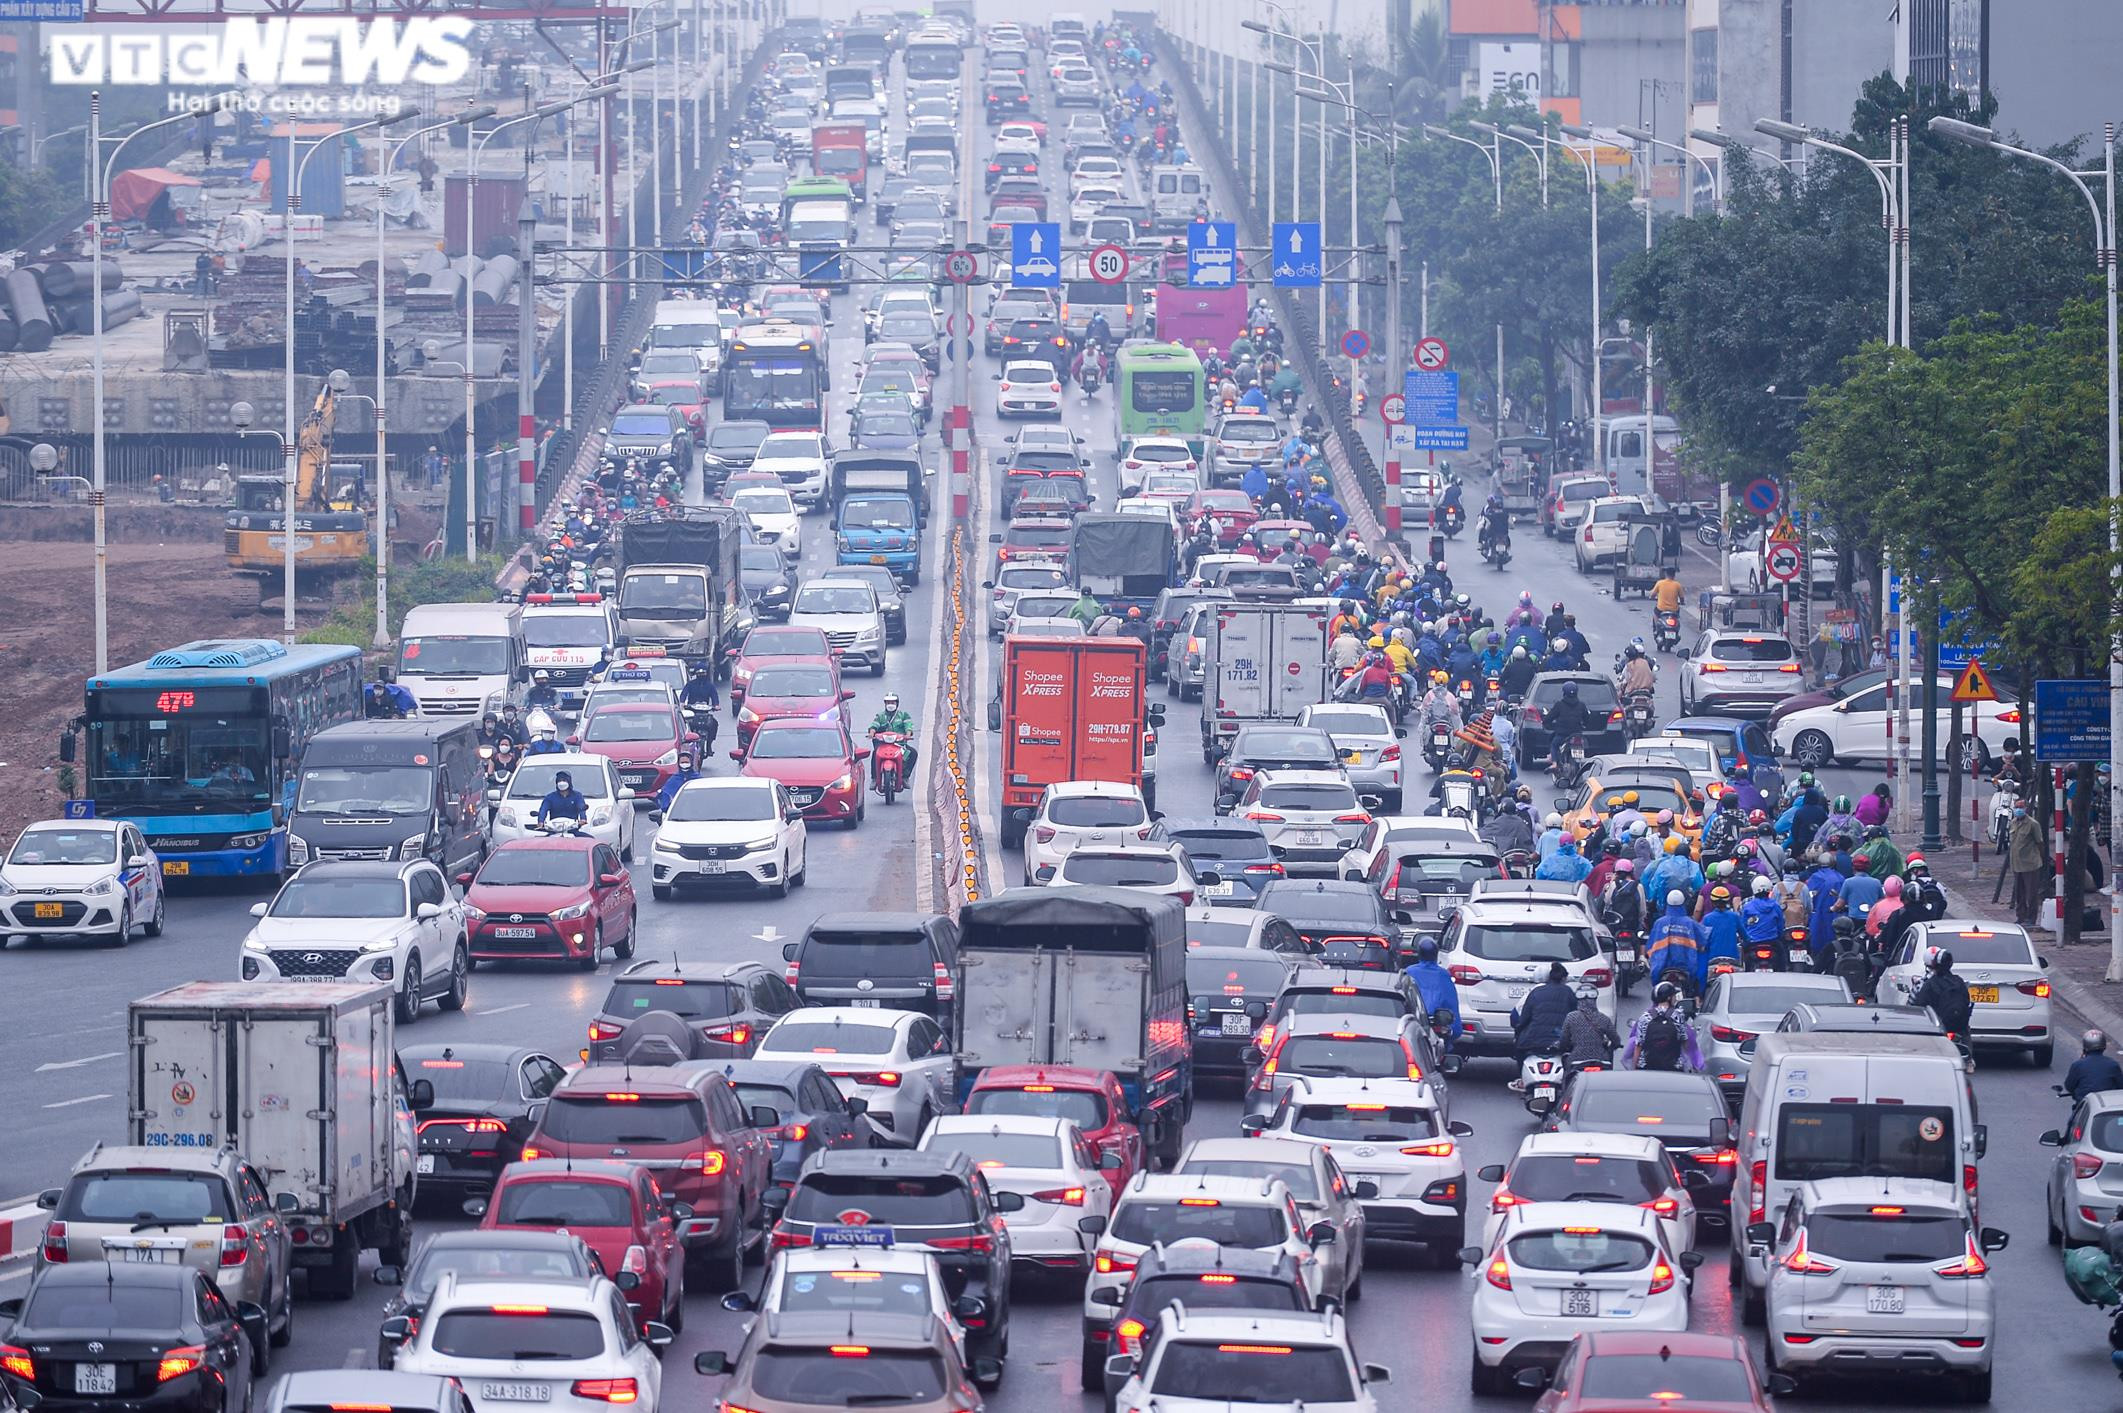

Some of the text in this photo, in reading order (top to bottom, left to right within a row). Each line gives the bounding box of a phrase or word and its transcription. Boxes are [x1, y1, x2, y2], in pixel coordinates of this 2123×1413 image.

[1101, 256, 1117, 272] 50
[571, 655, 584, 663] 115
[1235, 659, 1252, 670] 29H
[1024, 670, 1063, 683] Shopee
[1092, 672, 1131, 685] Shopee
[1227, 670, 1257, 681] 171.82
[1022, 684, 1063, 696] XPRESS
[1090, 685, 1132, 698] XPRESS
[1032, 726, 1061, 737] Shopee
[1229, 1015, 1244, 1024] 30F
[147, 1133, 213, 1147] 29C-296.08
[1568, 1291, 1591, 1302] 30Z
[1876, 1286, 1896, 1299] 30G
[1568, 1302, 1591, 1314] 5116
[85, 1366, 105, 1378] 30E
